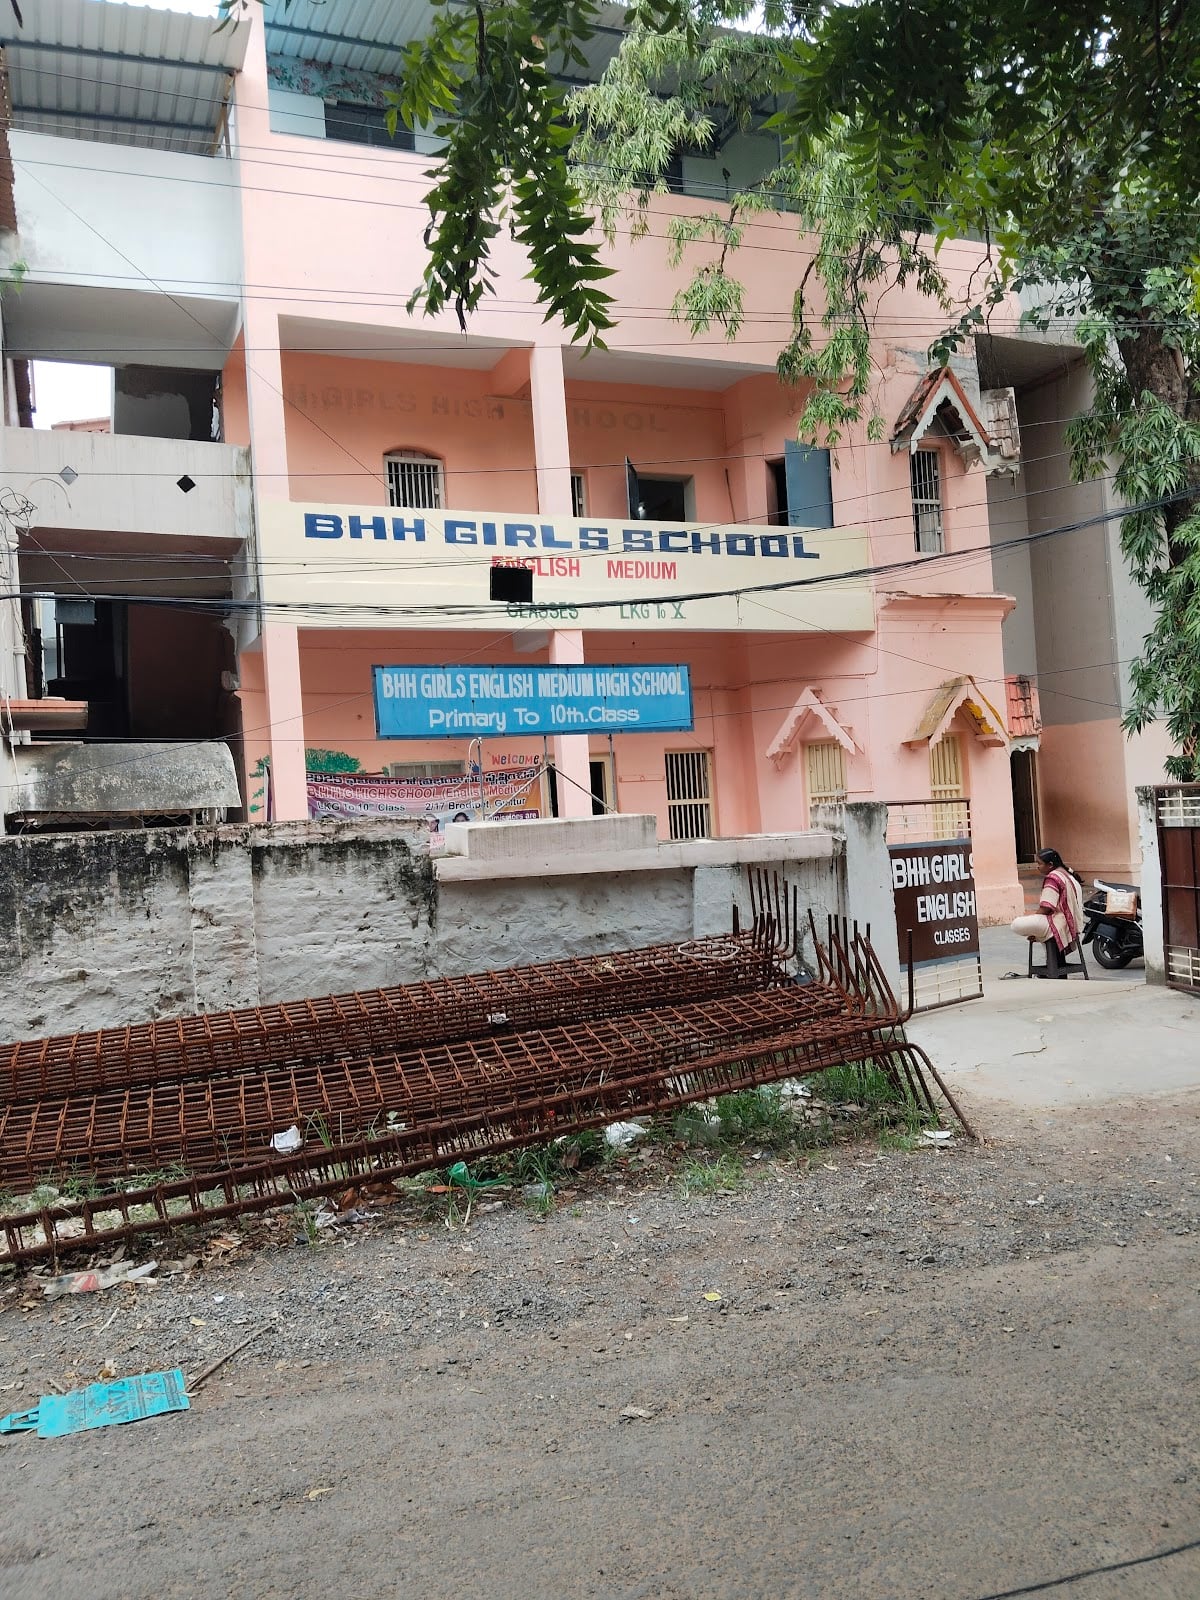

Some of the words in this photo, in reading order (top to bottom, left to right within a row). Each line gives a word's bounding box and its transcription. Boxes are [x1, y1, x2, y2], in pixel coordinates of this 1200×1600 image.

[303, 512, 425, 542] BHH
[444, 519, 609, 552] GIRLS
[623, 529, 820, 560] SCHOOL
[607, 559, 677, 579] MEDIUM
[506, 601, 579, 619] CLASSES
[620, 602, 650, 619] LKG
[671, 602, 686, 619] X
[382, 673, 417, 699] BHH
[420, 673, 467, 699] GIRLS
[470, 673, 533, 699] ENGLISH
[538, 672, 594, 698] MEDIUM
[596, 672, 630, 697] HIGH
[632, 671, 685, 696] SCHOOL
[429, 709, 506, 731] Primary
[513, 707, 540, 726] To
[306, 773, 342, 784] 2025
[356, 786, 388, 799] HIGH
[389, 787, 439, 799] SCHOOL
[318, 801, 340, 811] LKG
[378, 802, 405, 811] Class
[425, 802, 445, 811] 2/17
[916, 890, 976, 923] ENGLISH
[933, 927, 970, 945] CLASSES
